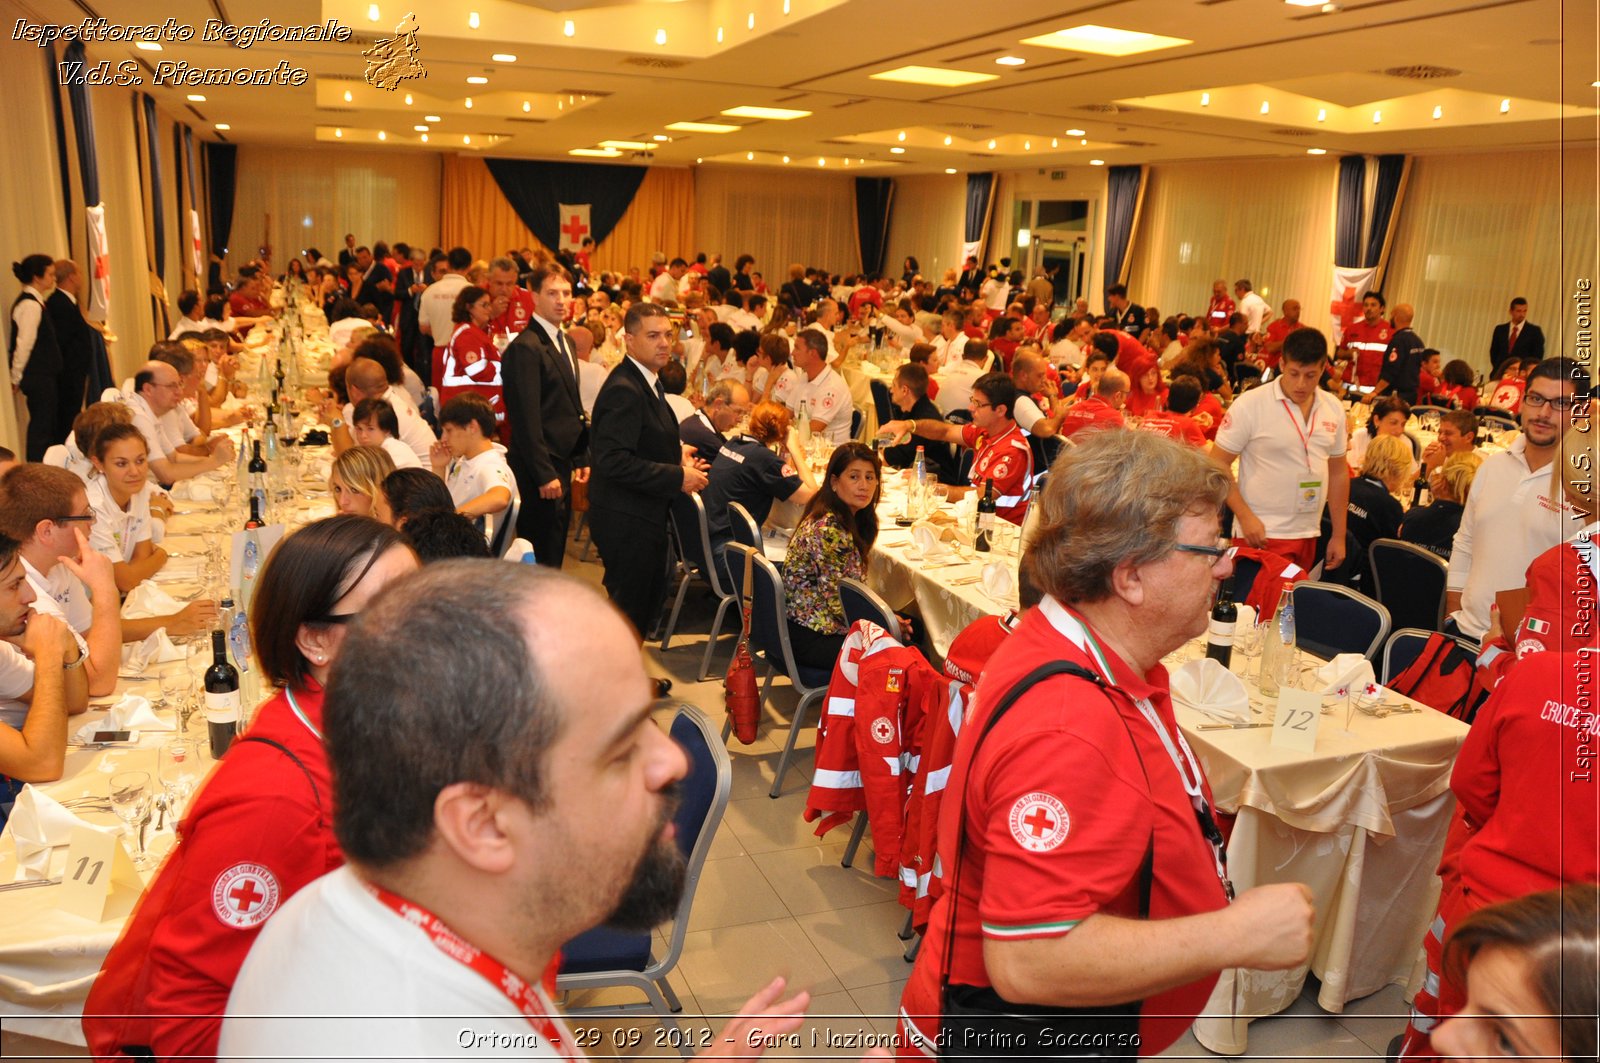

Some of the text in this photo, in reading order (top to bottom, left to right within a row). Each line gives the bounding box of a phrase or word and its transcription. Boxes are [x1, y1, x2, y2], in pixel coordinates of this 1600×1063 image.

[1281, 708, 1314, 731] 12
[1541, 700, 1580, 728] CROCE
[1031, 794, 1060, 808] GINEVRA
[72, 856, 104, 885] 11
